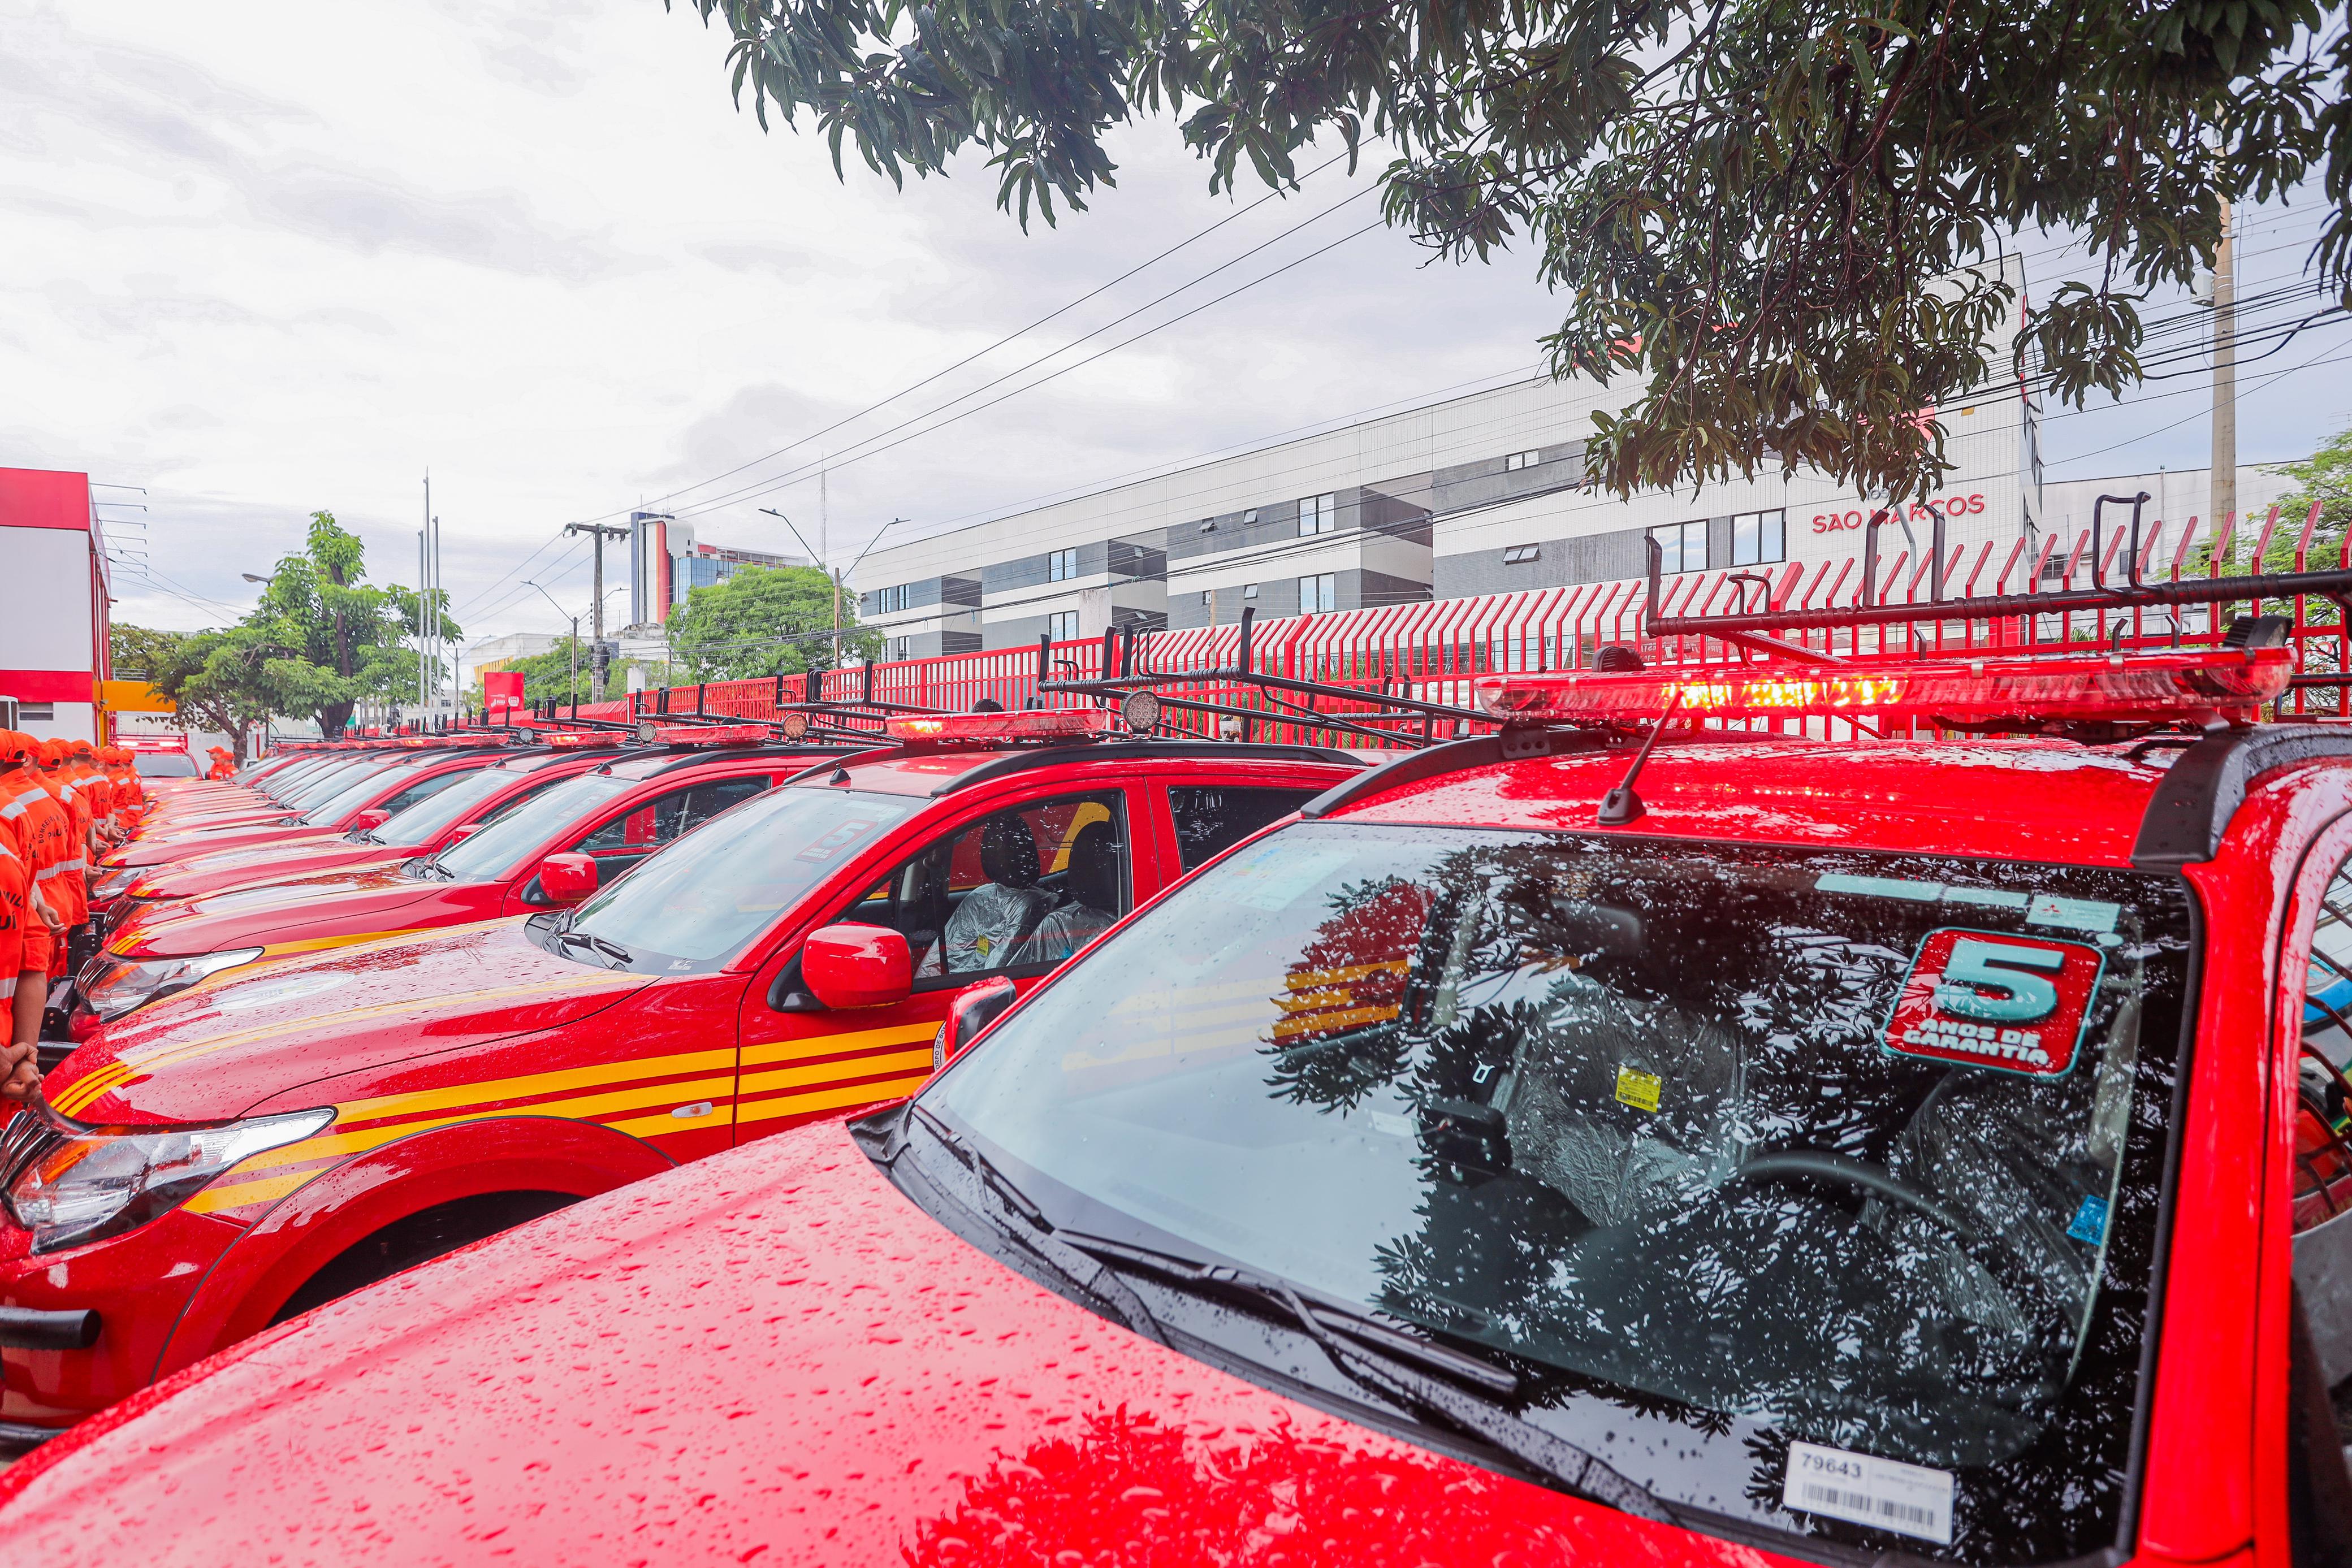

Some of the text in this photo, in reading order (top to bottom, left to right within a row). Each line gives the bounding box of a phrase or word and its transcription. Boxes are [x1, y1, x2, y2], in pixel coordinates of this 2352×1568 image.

[1932, 937, 2065, 1021] 5
[935, 1040, 942, 1049] DE
[1902, 1029, 2050, 1065] GARANTIA
[1918, 1017, 2042, 1048] ANOS DE
[1801, 1452, 1862, 1479] 79643
